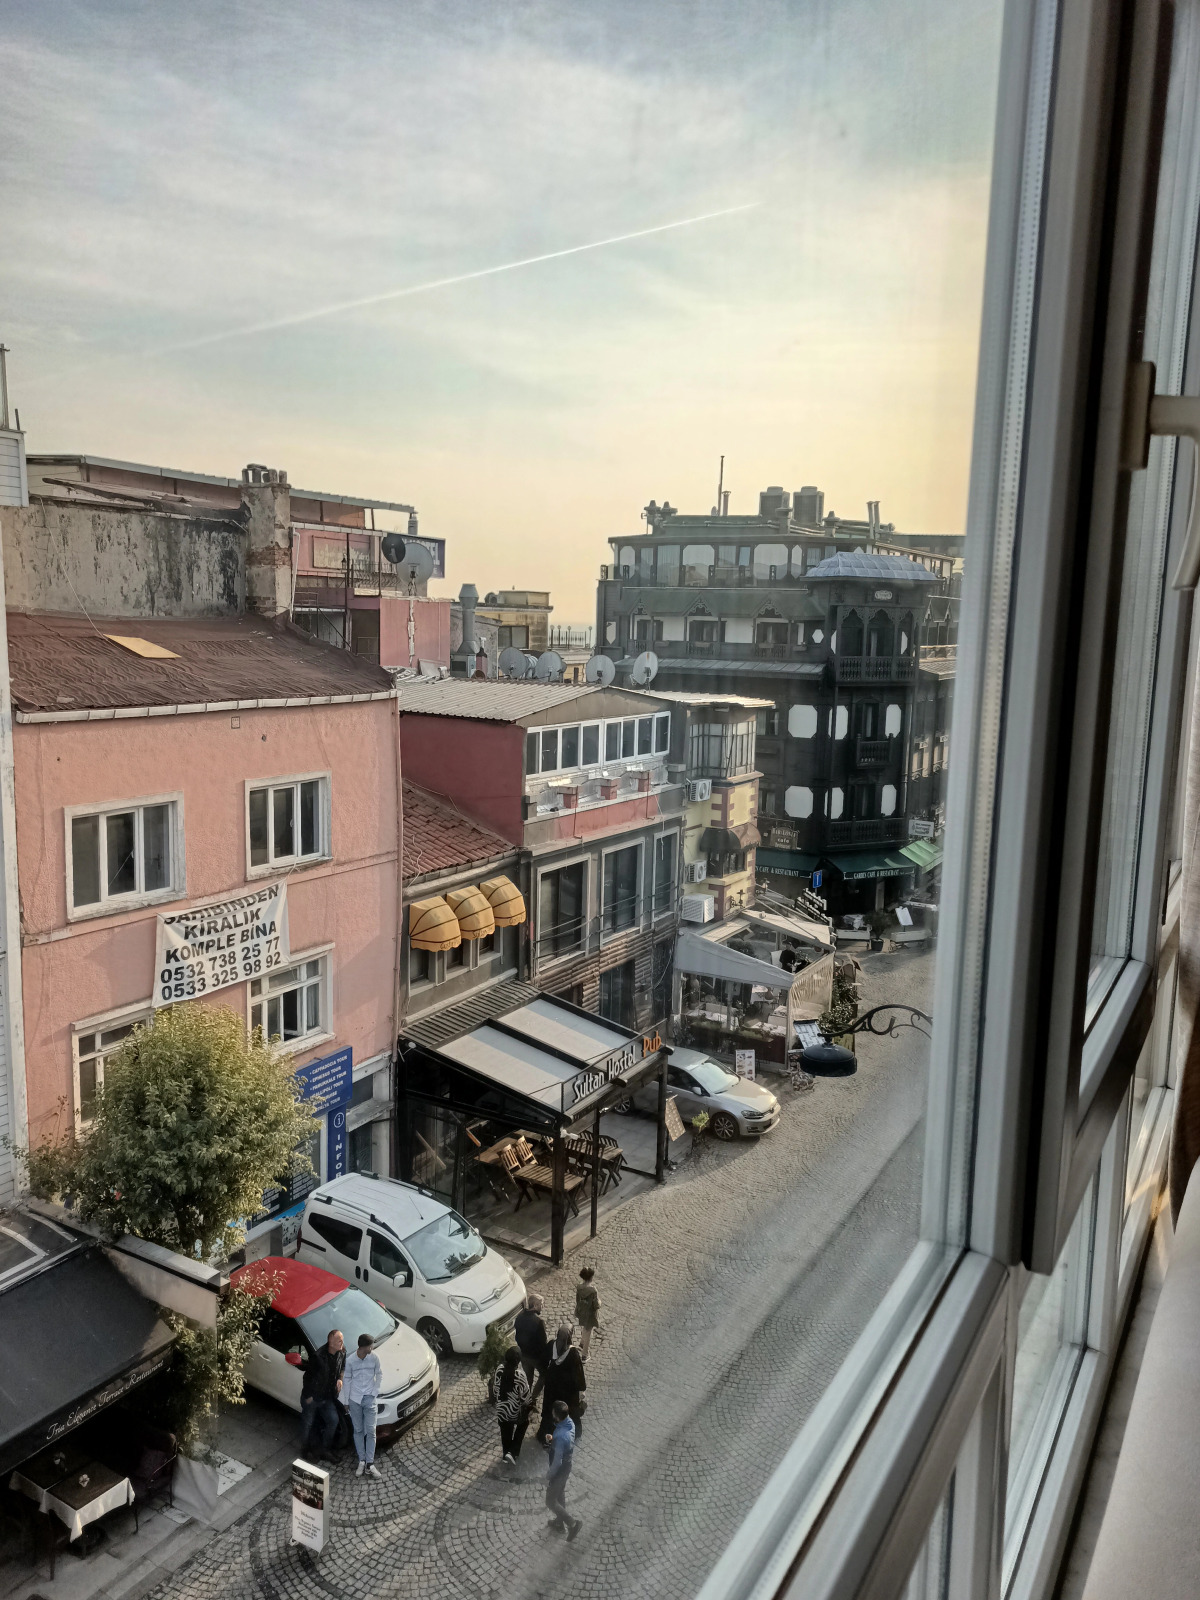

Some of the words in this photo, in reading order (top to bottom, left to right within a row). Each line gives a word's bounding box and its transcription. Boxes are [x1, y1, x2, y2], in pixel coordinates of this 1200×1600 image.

[165, 933, 236, 965] KOMPLE
[239, 920, 277, 944] BİNA
[183, 907, 262, 940] KİRALIK
[160, 961, 206, 984] 0532
[208, 950, 237, 972] 738
[241, 943, 262, 962] 25
[265, 935, 281, 954] 77
[161, 977, 207, 1001] 0533
[211, 966, 239, 988] 325
[242, 959, 262, 977] 98
[265, 951, 282, 969] 92
[573, 1070, 605, 1104] Sultan
[607, 1044, 637, 1081] Hostel
[641, 1030, 662, 1058] Pub
[98, 1388, 124, 1407] Terrace
[125, 1360, 164, 1390] Restaurant
